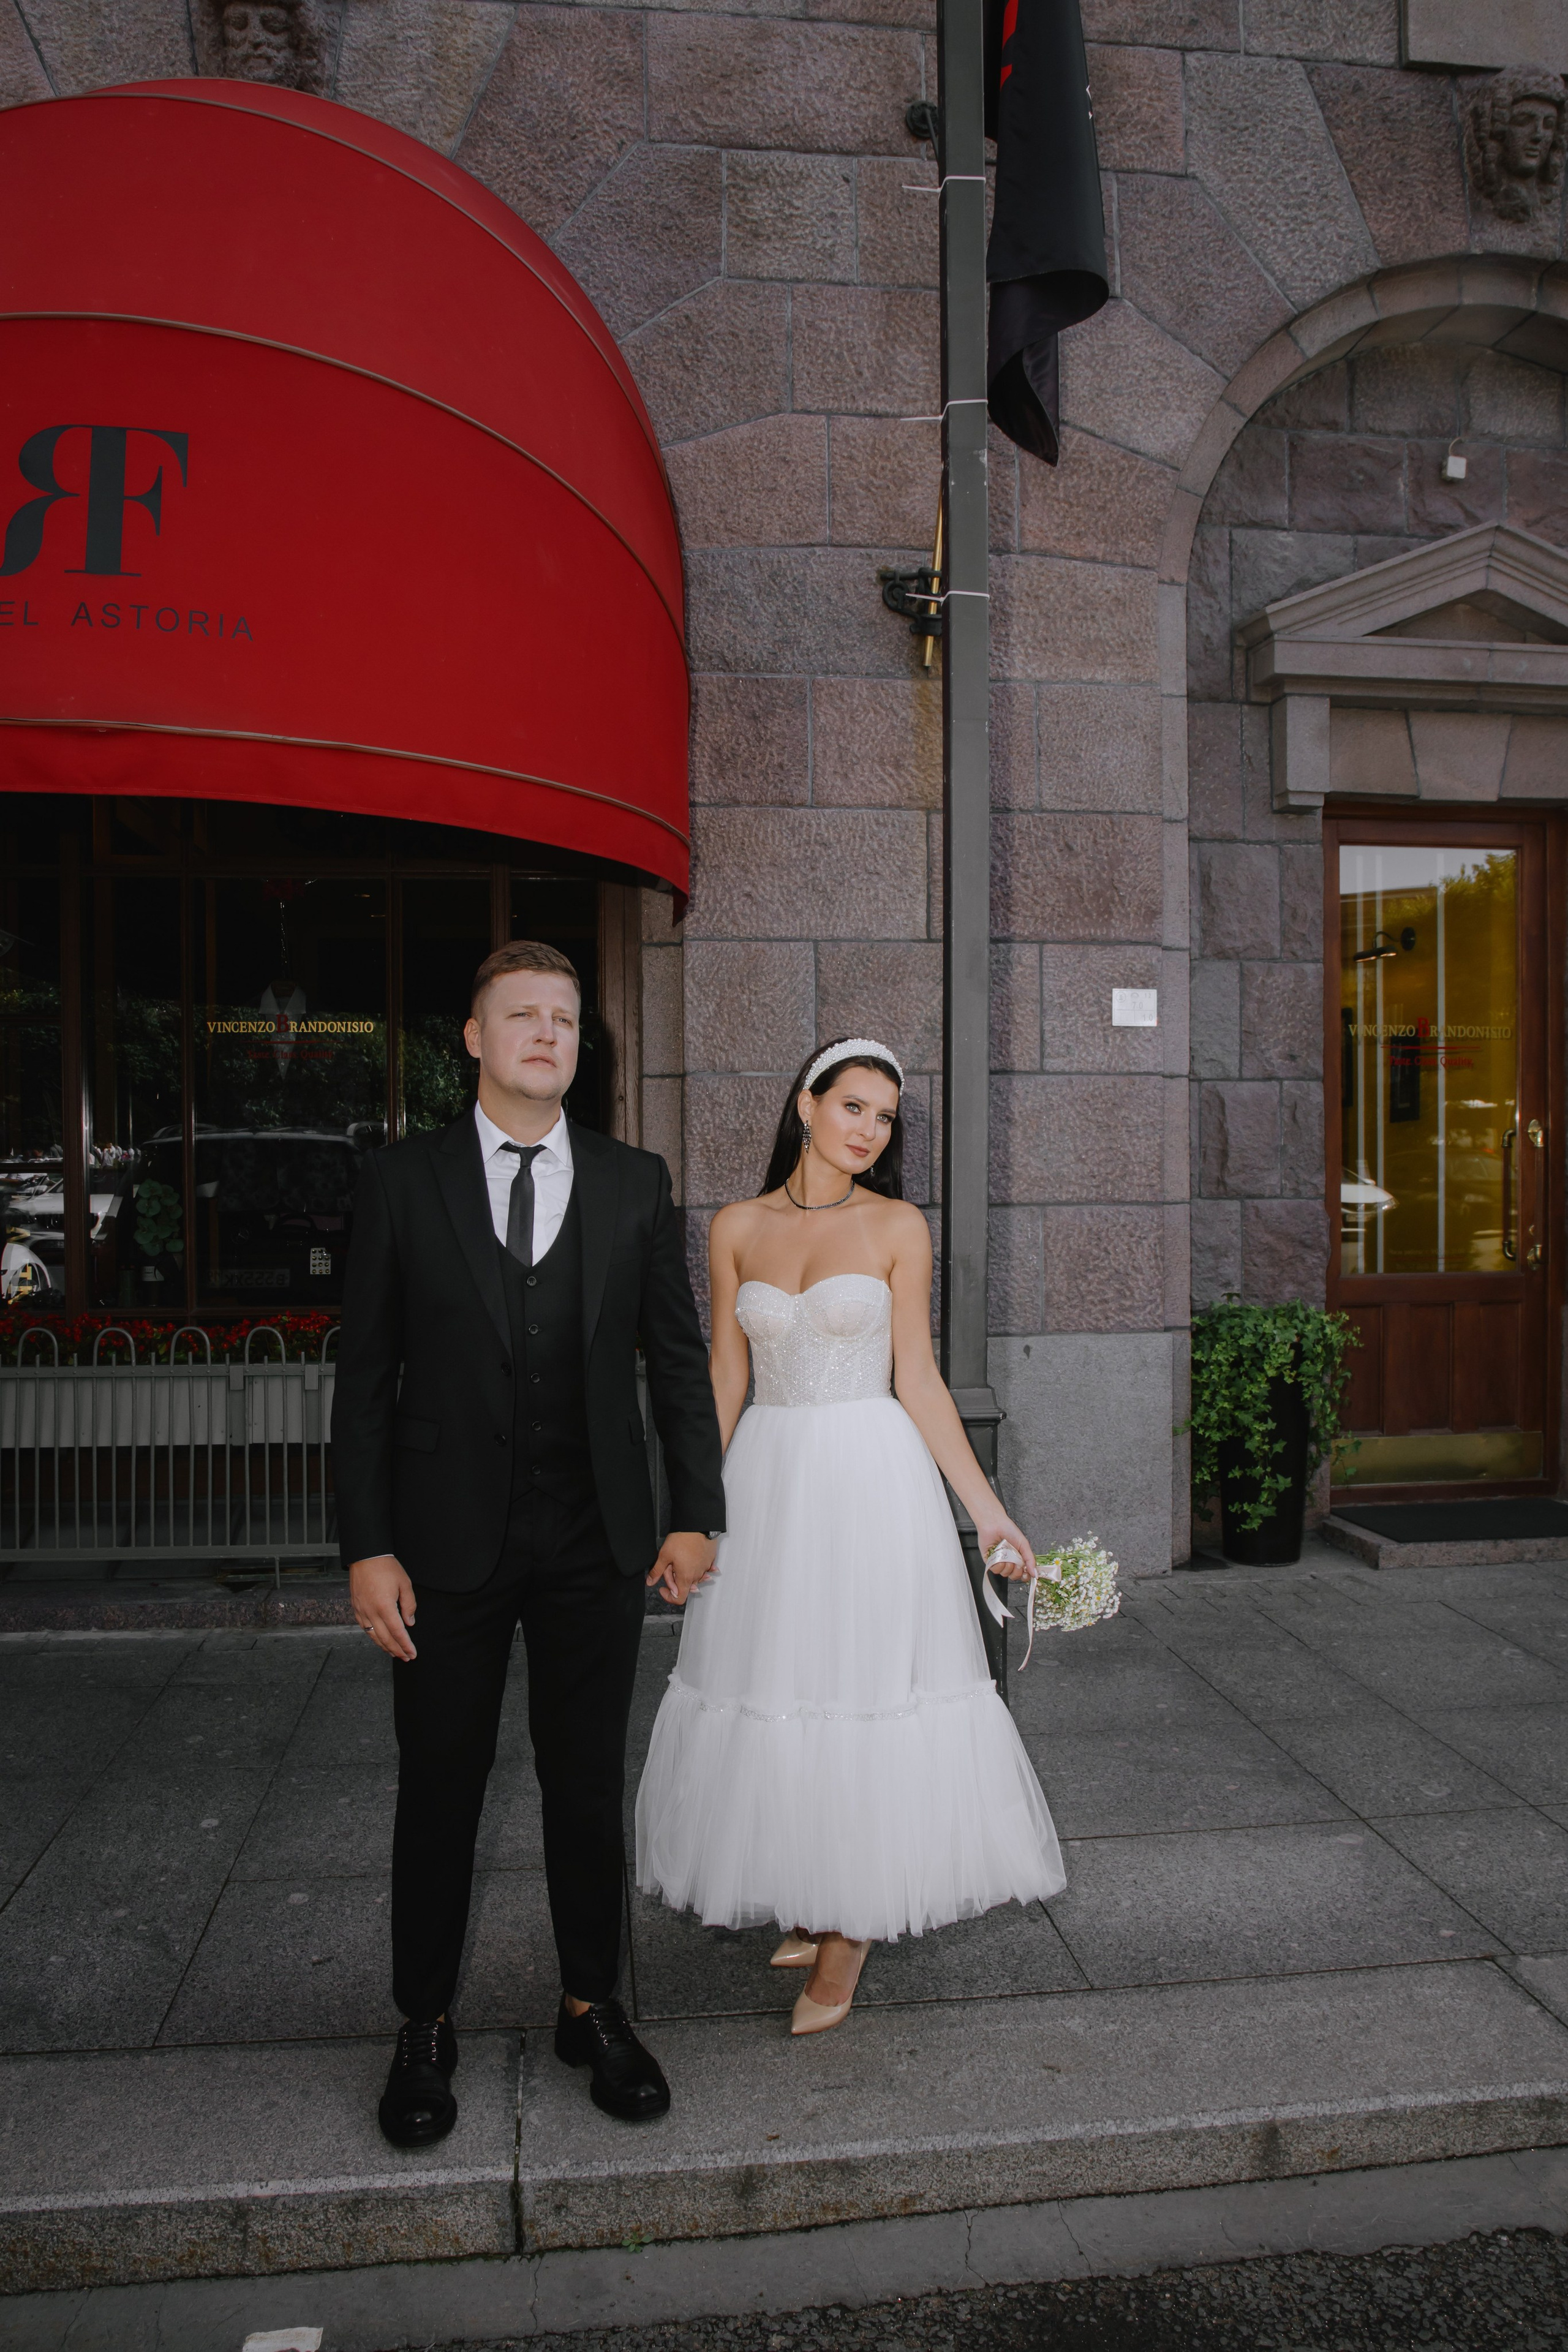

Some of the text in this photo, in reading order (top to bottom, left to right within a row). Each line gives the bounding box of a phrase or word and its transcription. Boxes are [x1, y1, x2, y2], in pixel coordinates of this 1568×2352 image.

[71, 602, 253, 641] ASTORIA
[207, 1014, 374, 1033] VINCENZO BRANDONISIO
[1348, 1024, 1416, 1037] VNCENZO
